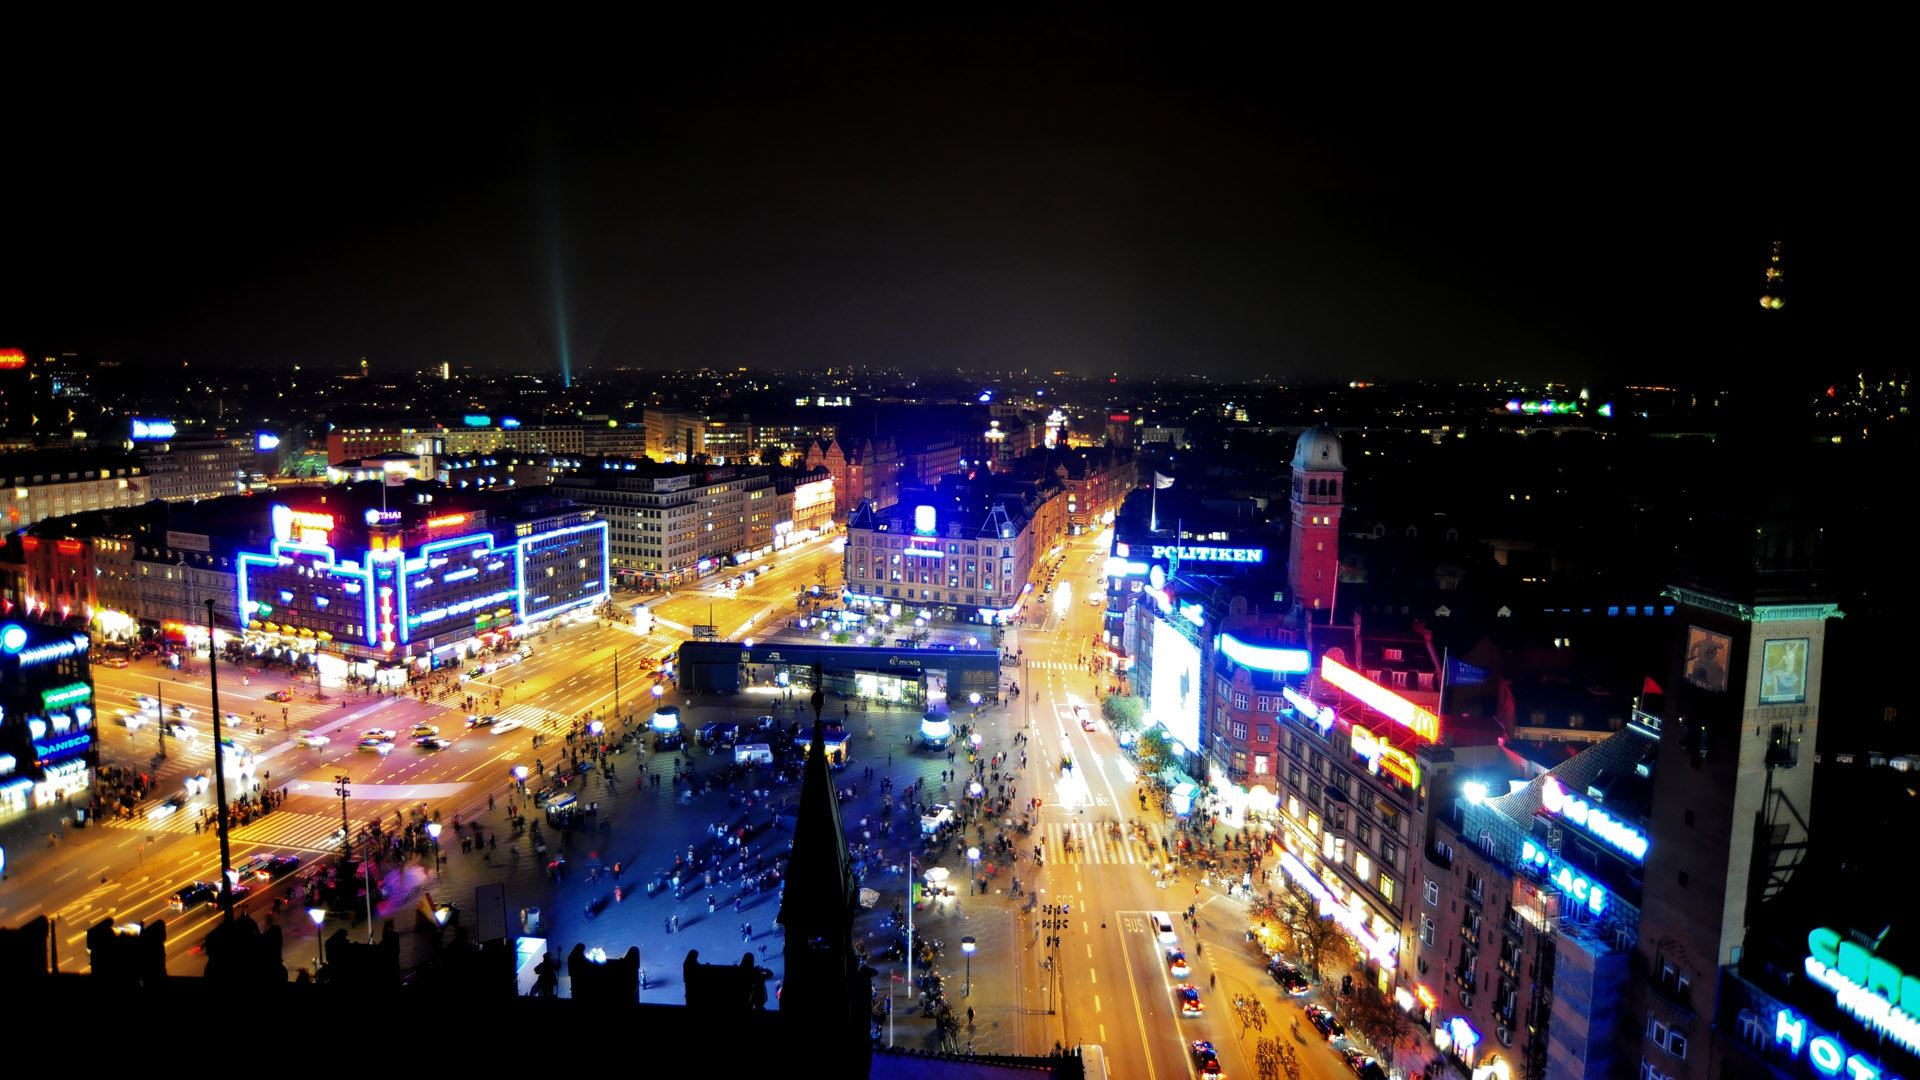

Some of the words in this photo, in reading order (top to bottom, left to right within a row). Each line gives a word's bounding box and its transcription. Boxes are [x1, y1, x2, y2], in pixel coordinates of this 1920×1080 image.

[378, 511, 402, 520] THAI
[1152, 545, 1263, 562] POLITIKEN
[899, 659, 920, 667] movia
[36, 734, 90, 756] DANISCO
[1124, 918, 1144, 933] BUS
